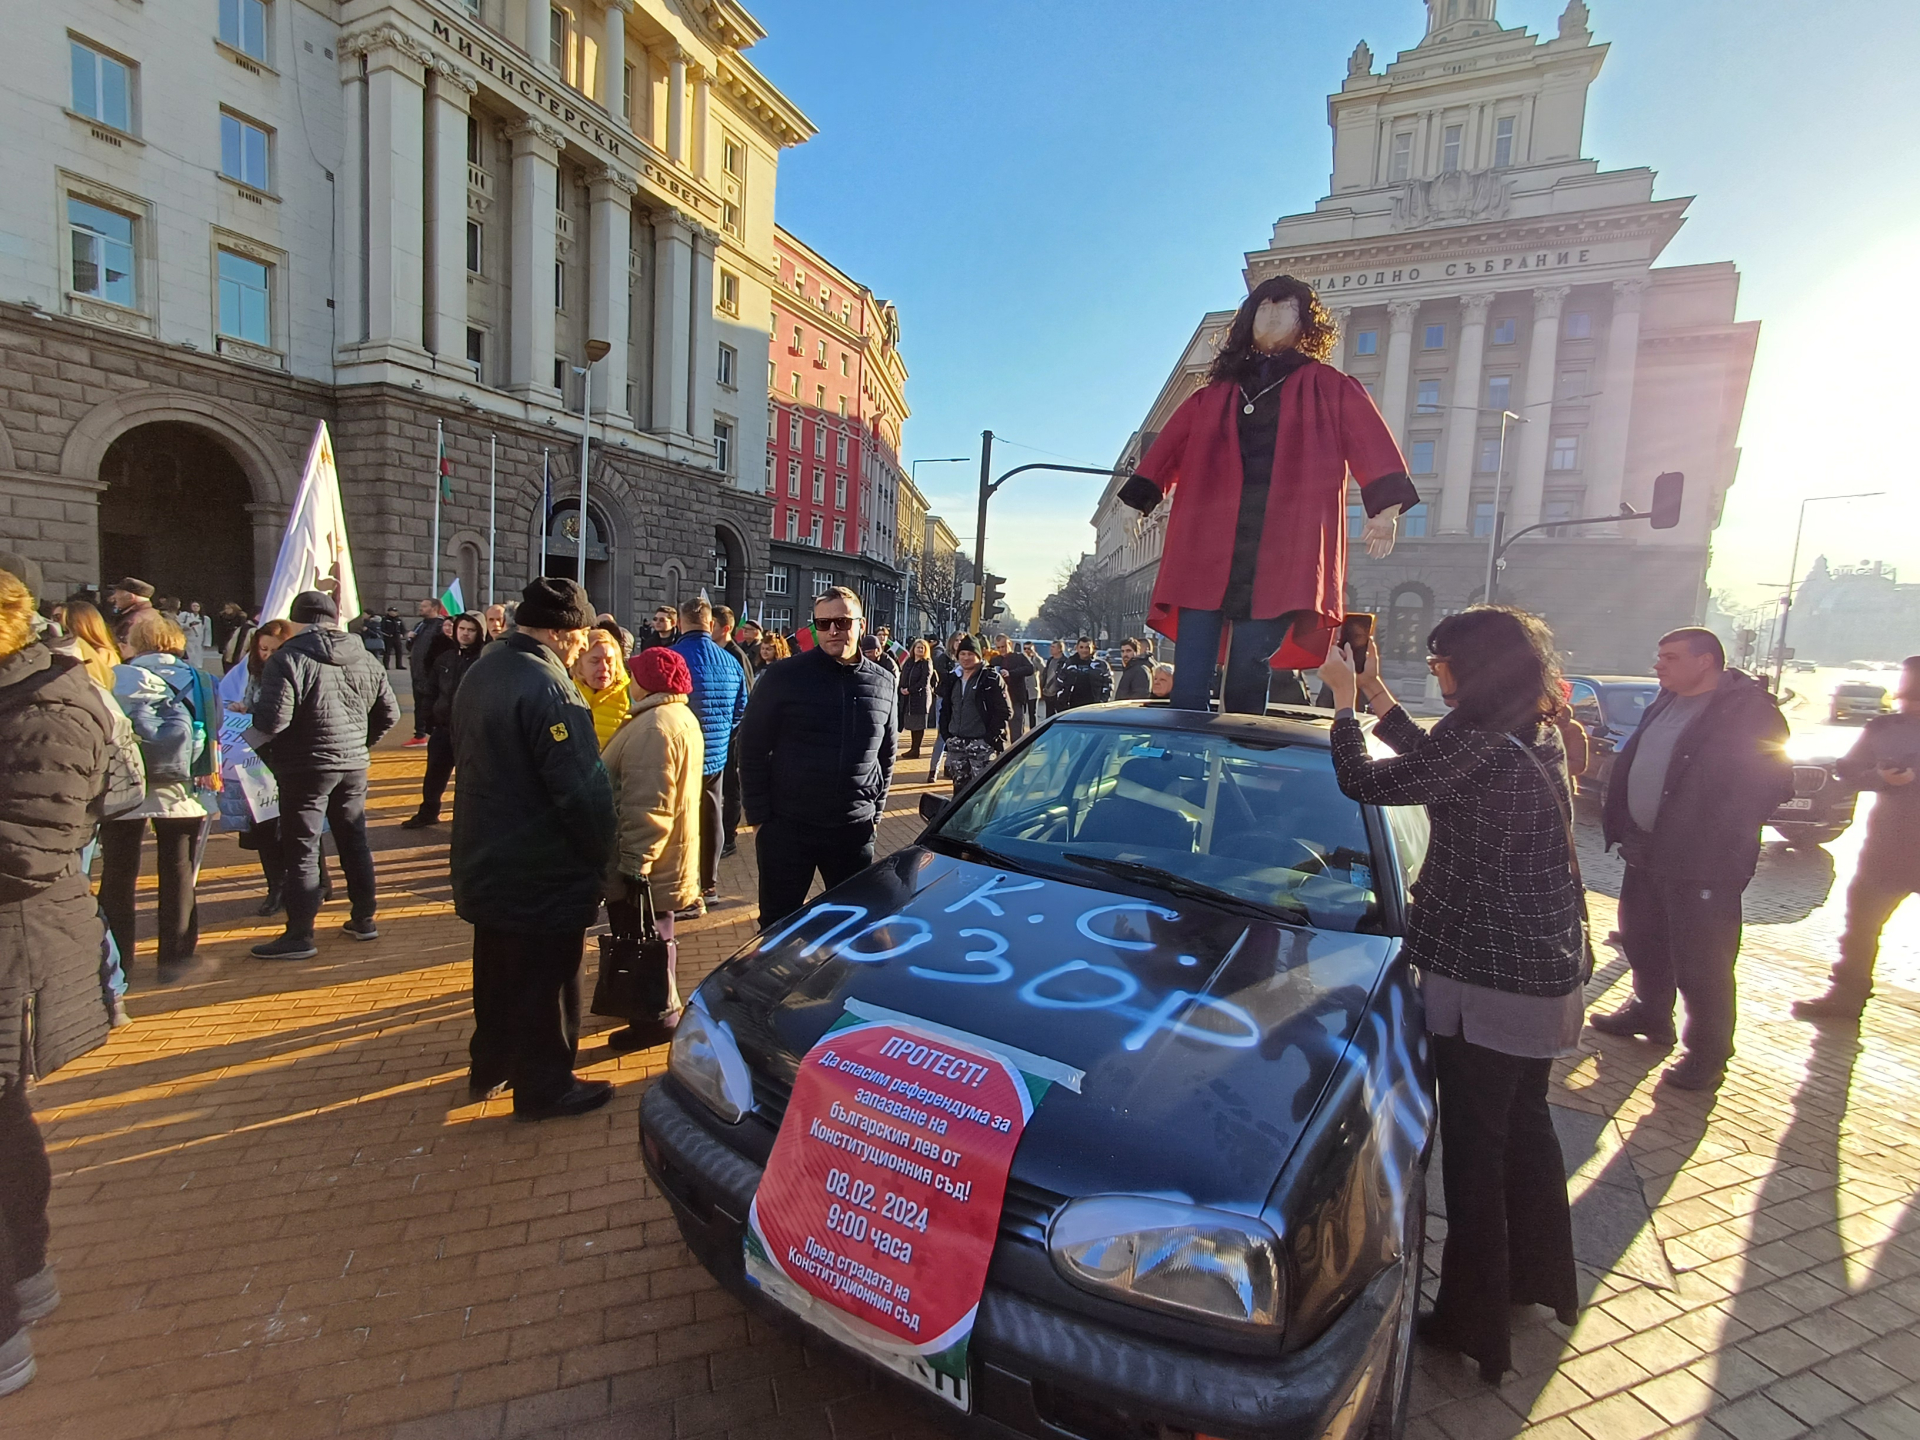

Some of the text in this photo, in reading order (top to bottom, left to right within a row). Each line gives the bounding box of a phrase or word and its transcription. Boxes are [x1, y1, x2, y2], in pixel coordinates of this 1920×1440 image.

[432, 18, 702, 209] МИНИСТЕРСКИ СЪВЕТ
[1311, 249, 1591, 291] НАРОДНО СЪБРАНИЕ
[758, 902, 1262, 1052] ПОЗОР
[818, 1050, 1012, 1133] Да спасим референдума за
[879, 1036, 989, 1088] ПРОТЕСТ!
[829, 1100, 962, 1168] българския лев от
[854, 1088, 948, 1135] запазване на
[809, 1117, 972, 1201] Конституционния съд!
[826, 1168, 929, 1233] 08.02. 2024
[827, 1203, 913, 1264] 9:00 часа
[788, 1246, 920, 1333] Конституционния съд
[804, 1235, 911, 1304] Пред сградата на
